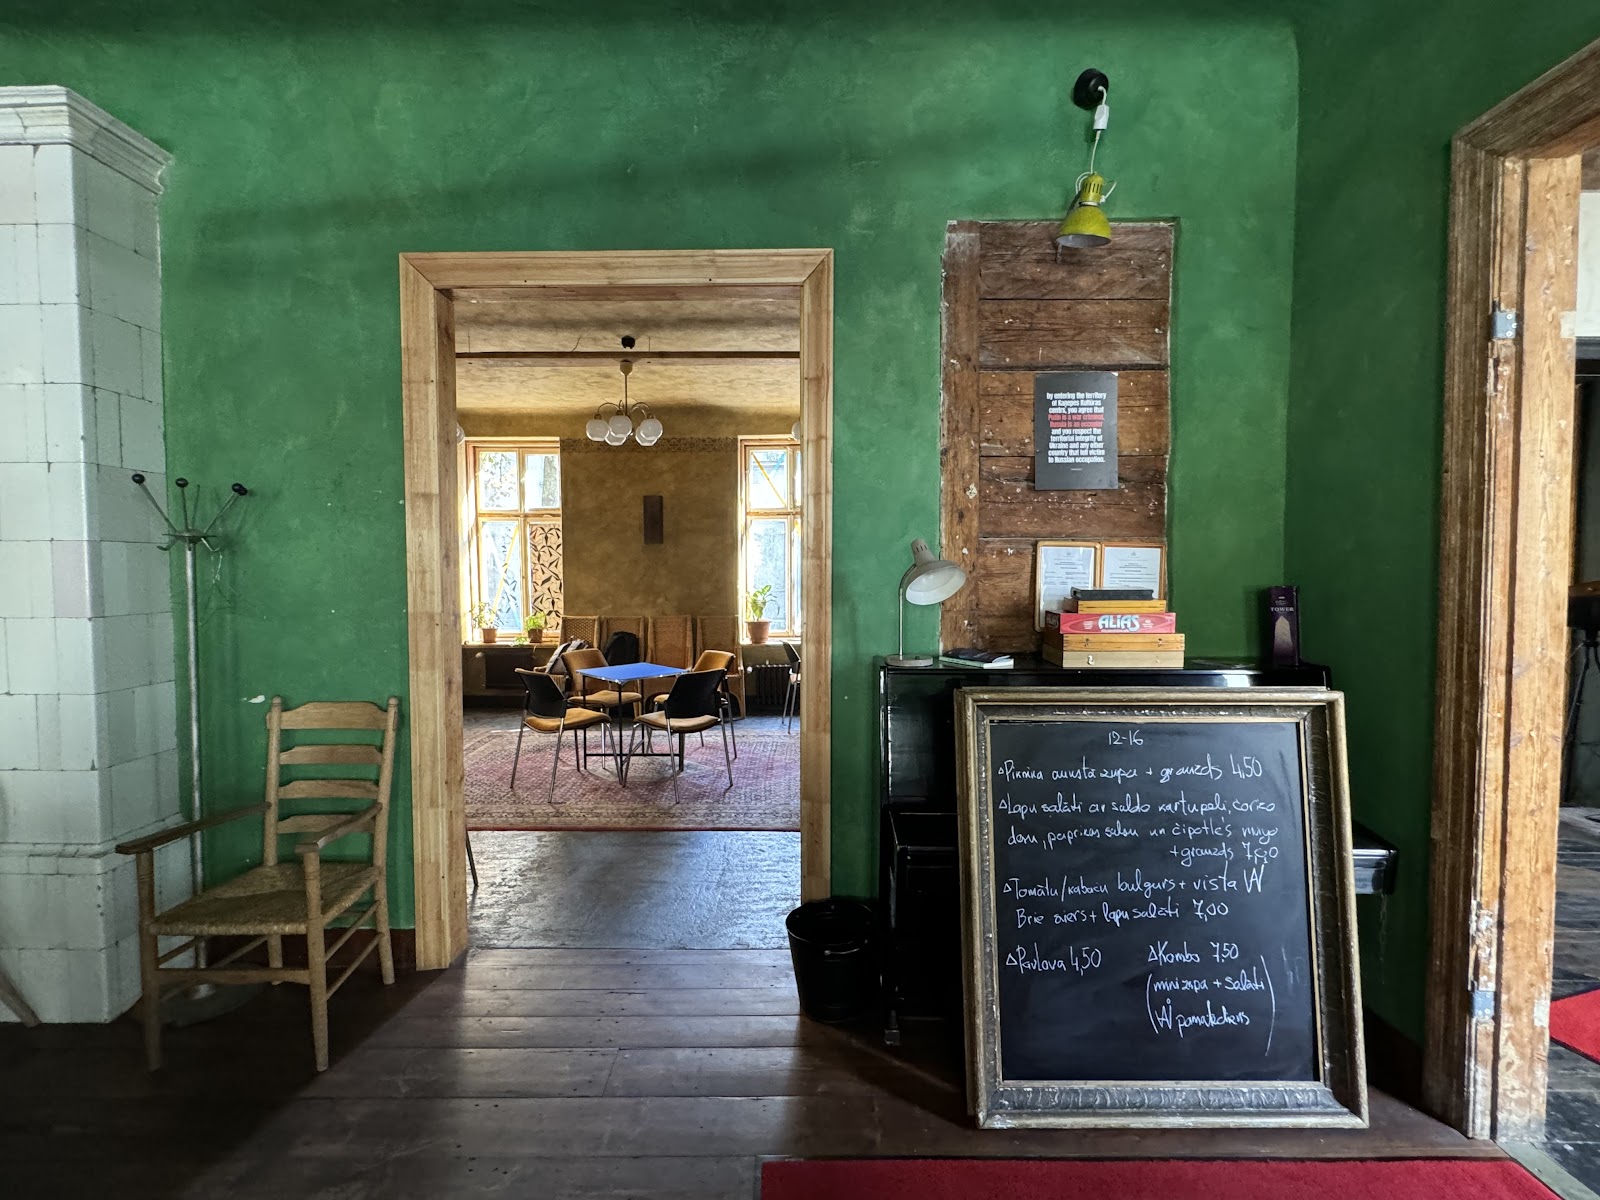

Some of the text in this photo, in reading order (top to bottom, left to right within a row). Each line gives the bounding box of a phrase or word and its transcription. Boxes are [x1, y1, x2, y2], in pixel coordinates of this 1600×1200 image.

[1047, 392, 1053, 400] by
[1054, 392, 1075, 400] entering
[1108, 730, 1143, 745] 12-16
[1089, 803, 1105, 812] ar
[1016, 908, 1044, 928] Brie
[1070, 946, 1101, 976] 4,50
